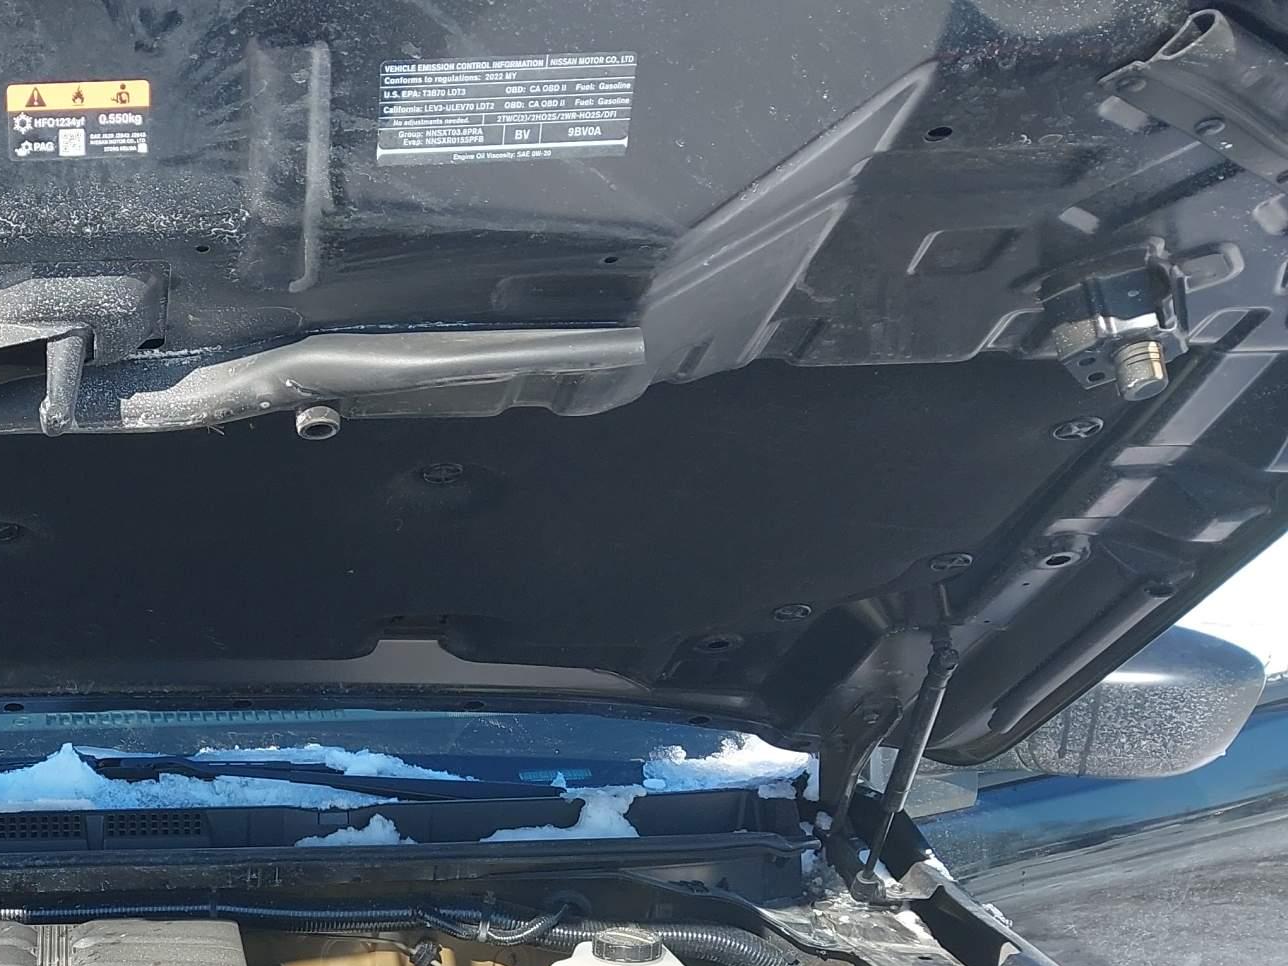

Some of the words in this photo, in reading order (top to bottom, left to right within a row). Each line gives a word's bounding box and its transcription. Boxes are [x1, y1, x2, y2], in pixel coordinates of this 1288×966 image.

[384, 64, 417, 73] VEHICLE
[417, 62, 455, 72] EMISSION
[456, 61, 492, 70] CONTROL
[492, 59, 544, 69] INFORMATION
[550, 57, 578, 66] NISSAN
[578, 56, 605, 65] MOTOR
[621, 55, 634, 63] LTD
[384, 76, 423, 85] Conforms
[424, 75, 433, 83] to
[434, 74, 481, 84] regulations:
[485, 73, 504, 81] 2022
[505, 71, 518, 80] MY
[505, 86, 526, 94] OBD:
[529, 85, 541, 93] CA
[542, 84, 560, 92] OBD
[576, 83, 596, 91] Fuel:
[598, 82, 631, 90] Gasoline
[383, 90, 401, 99] U.S.
[401, 89, 421, 98] EPA:
[504, 101, 525, 109] OBD:
[528, 100, 540, 108] CA
[541, 99, 559, 107] OBD
[575, 98, 594, 106] Fuel:
[597, 97, 630, 105] Gasoline
[383, 106, 423, 115] California:
[424, 103, 474, 112] LEV3-ULEV70
[34, 116, 86, 129] HFO1234yf
[98, 112, 144, 126] 0.550kg
[403, 118, 443, 126] adjustments
[398, 130, 424, 138] Group:
[514, 129, 531, 140] BV
[33, 141, 55, 152] PAG
[403, 138, 424, 146] Evap:
[453, 153, 475, 161] Engine
[475, 152, 486, 160] Oil
[516, 150, 530, 158] SAE
